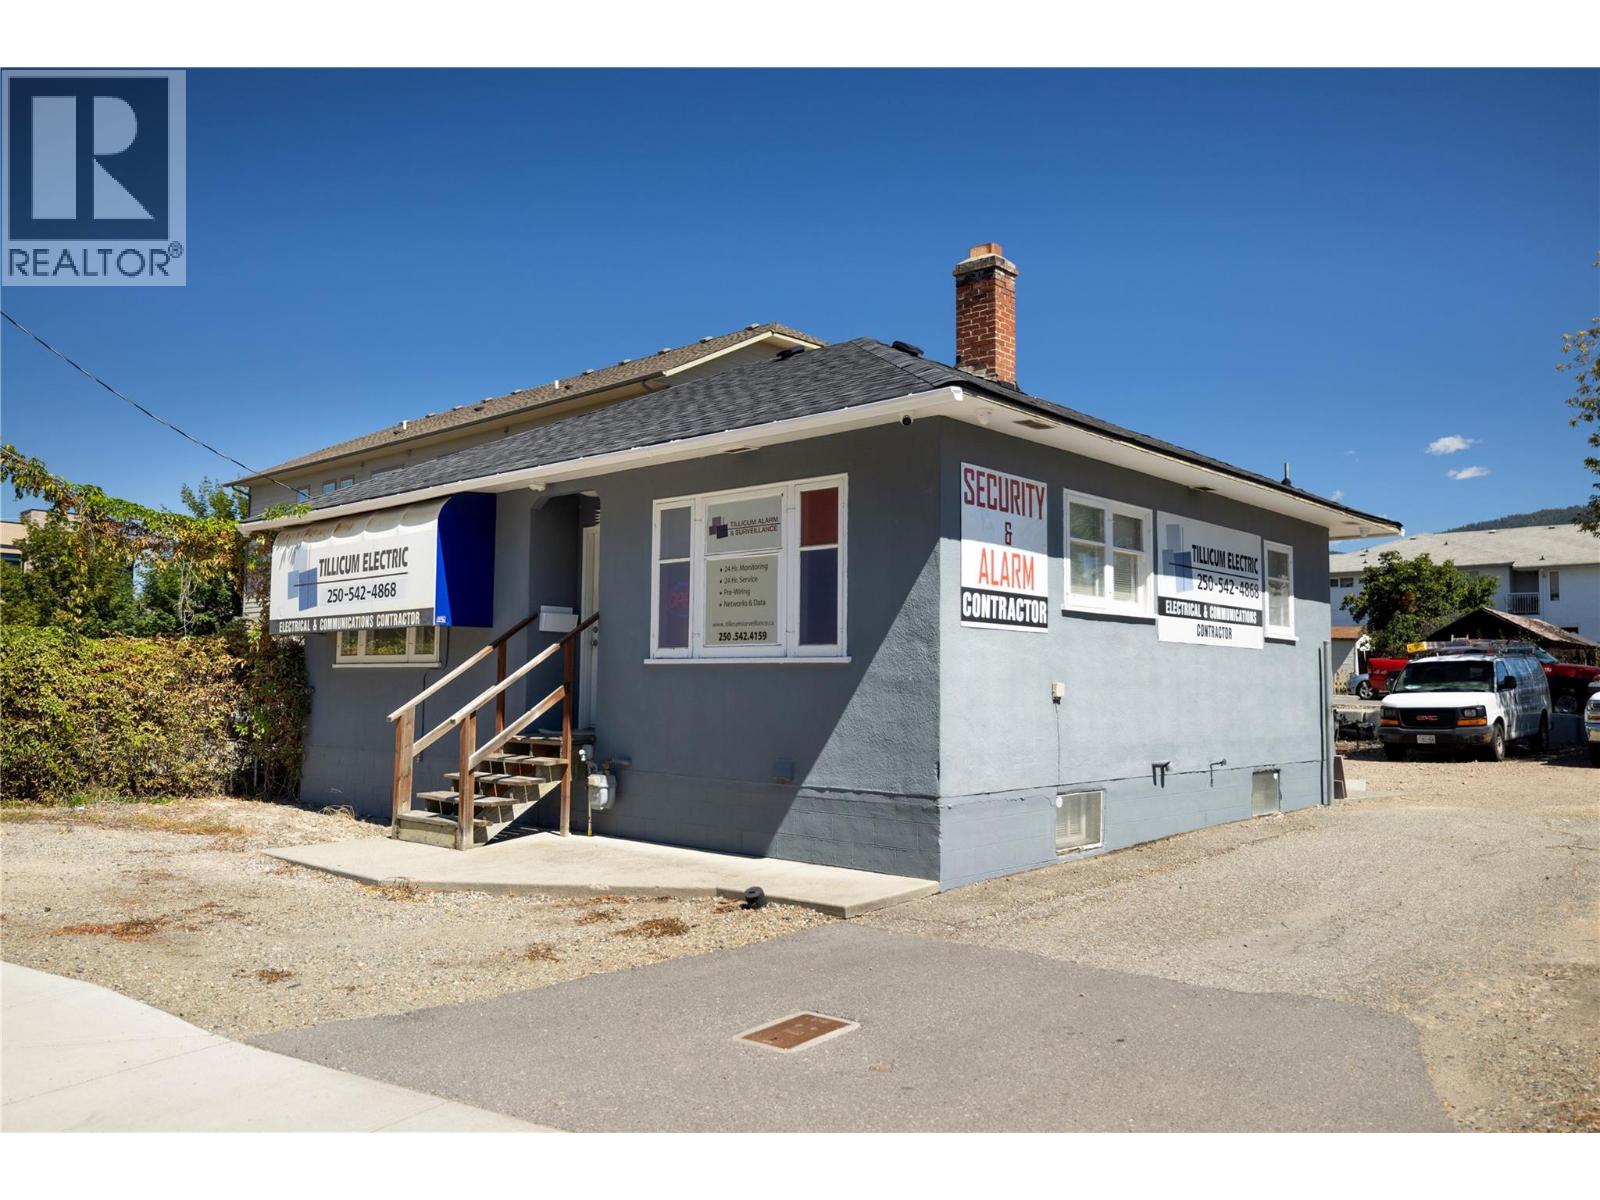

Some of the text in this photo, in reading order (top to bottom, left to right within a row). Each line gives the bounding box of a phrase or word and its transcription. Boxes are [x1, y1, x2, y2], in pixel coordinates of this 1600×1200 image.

[963, 467, 1046, 520] SECURITY
[730, 516, 779, 527] TILLICUM ALARM
[735, 525, 777, 536] SURVEILLANCE
[1004, 521, 1013, 546] &
[319, 546, 409, 577] TILLICUM ELECTRIC
[739, 563, 769, 572] Monitoring
[978, 547, 1035, 591] ALARM
[1191, 544, 1259, 575] TILLICUM ELECTRIC
[739, 575, 758, 583] Service
[1197, 573, 1260, 600] 250-542-4868
[327, 582, 397, 604] 250-542-4868
[724, 588, 751, 597] Pre-Wiring
[724, 599, 748, 608] Networks
[753, 598, 766, 606] Data
[962, 591, 1047, 624] CONTRACTOR
[1165, 600, 1257, 625] ELECTRICAL & COMMUNICATIONS
[279, 617, 310, 633] ELECTRICAL
[312, 617, 318, 631] &
[319, 614, 374, 631] COMMUNICATIONS
[376, 611, 420, 627] CONTRACTOR
[1196, 623, 1233, 640] CONTRACTOR
